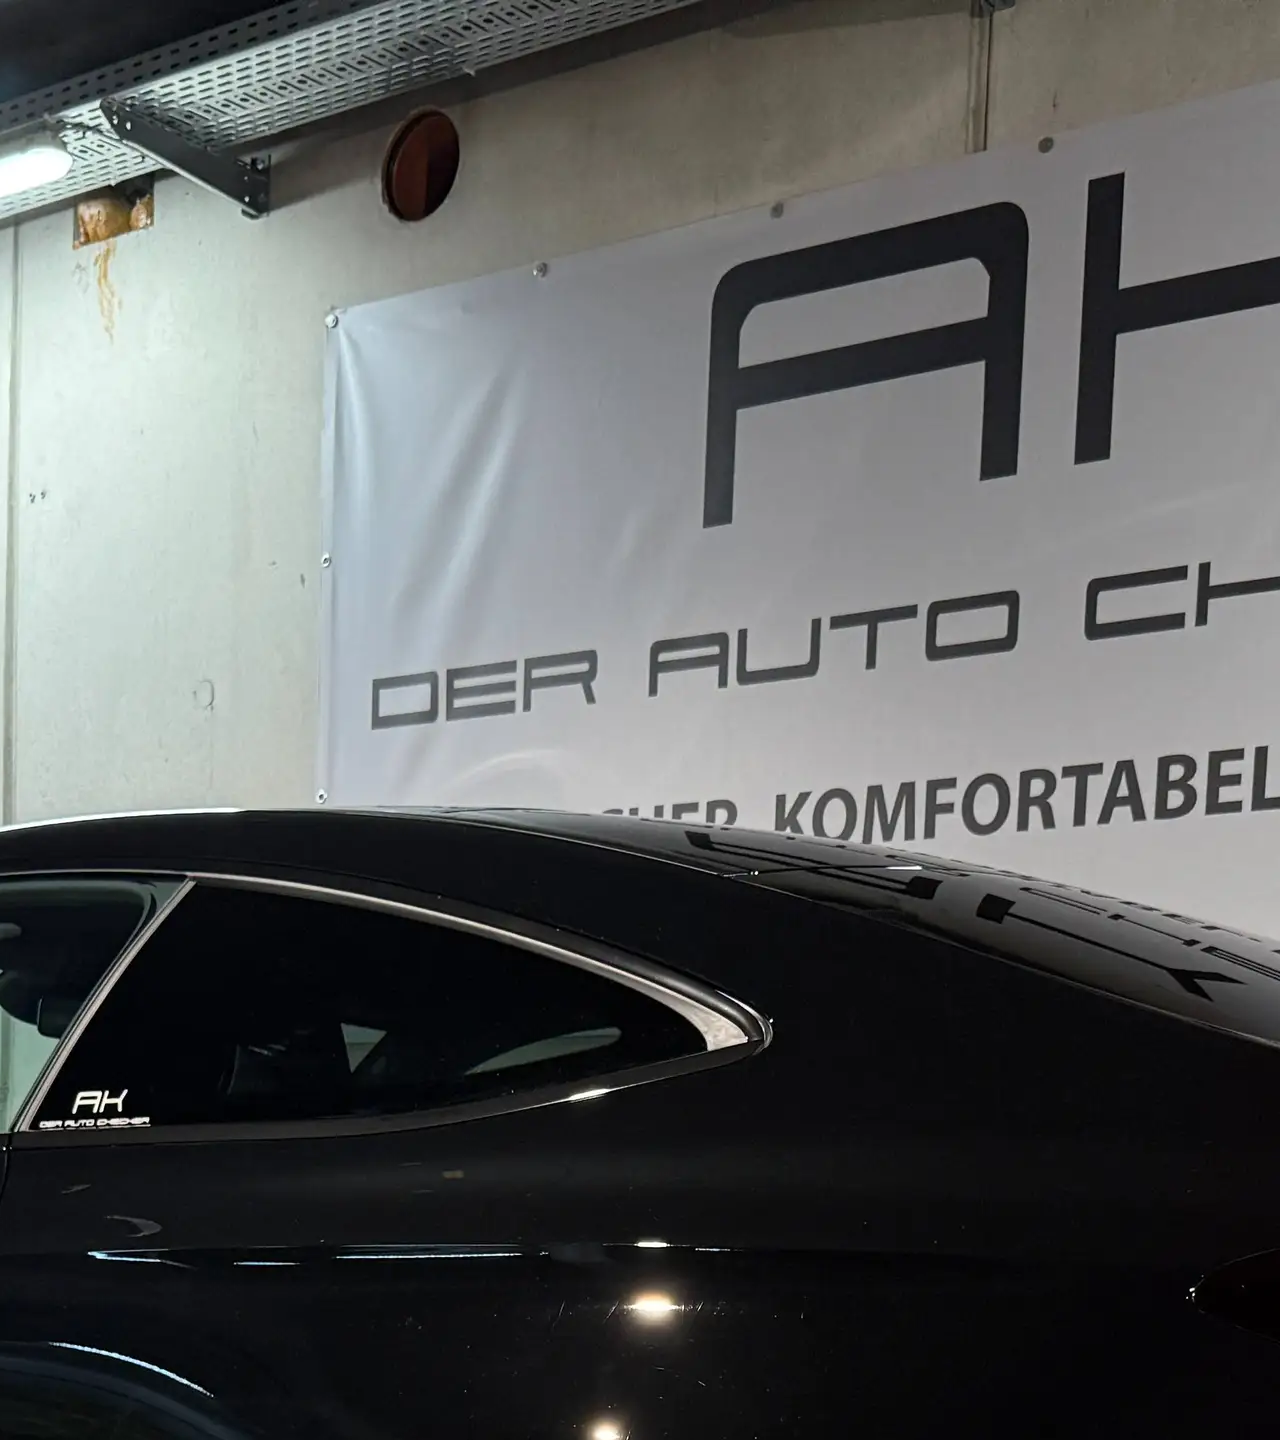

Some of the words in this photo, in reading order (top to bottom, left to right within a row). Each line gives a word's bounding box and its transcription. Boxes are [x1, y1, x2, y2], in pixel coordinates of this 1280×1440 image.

[372, 650, 597, 728] DER
[649, 590, 1019, 696] AUTO
[72, 1089, 128, 1114] AK
[39, 1119, 63, 1128] DER
[63, 1118, 95, 1127] AUTO
